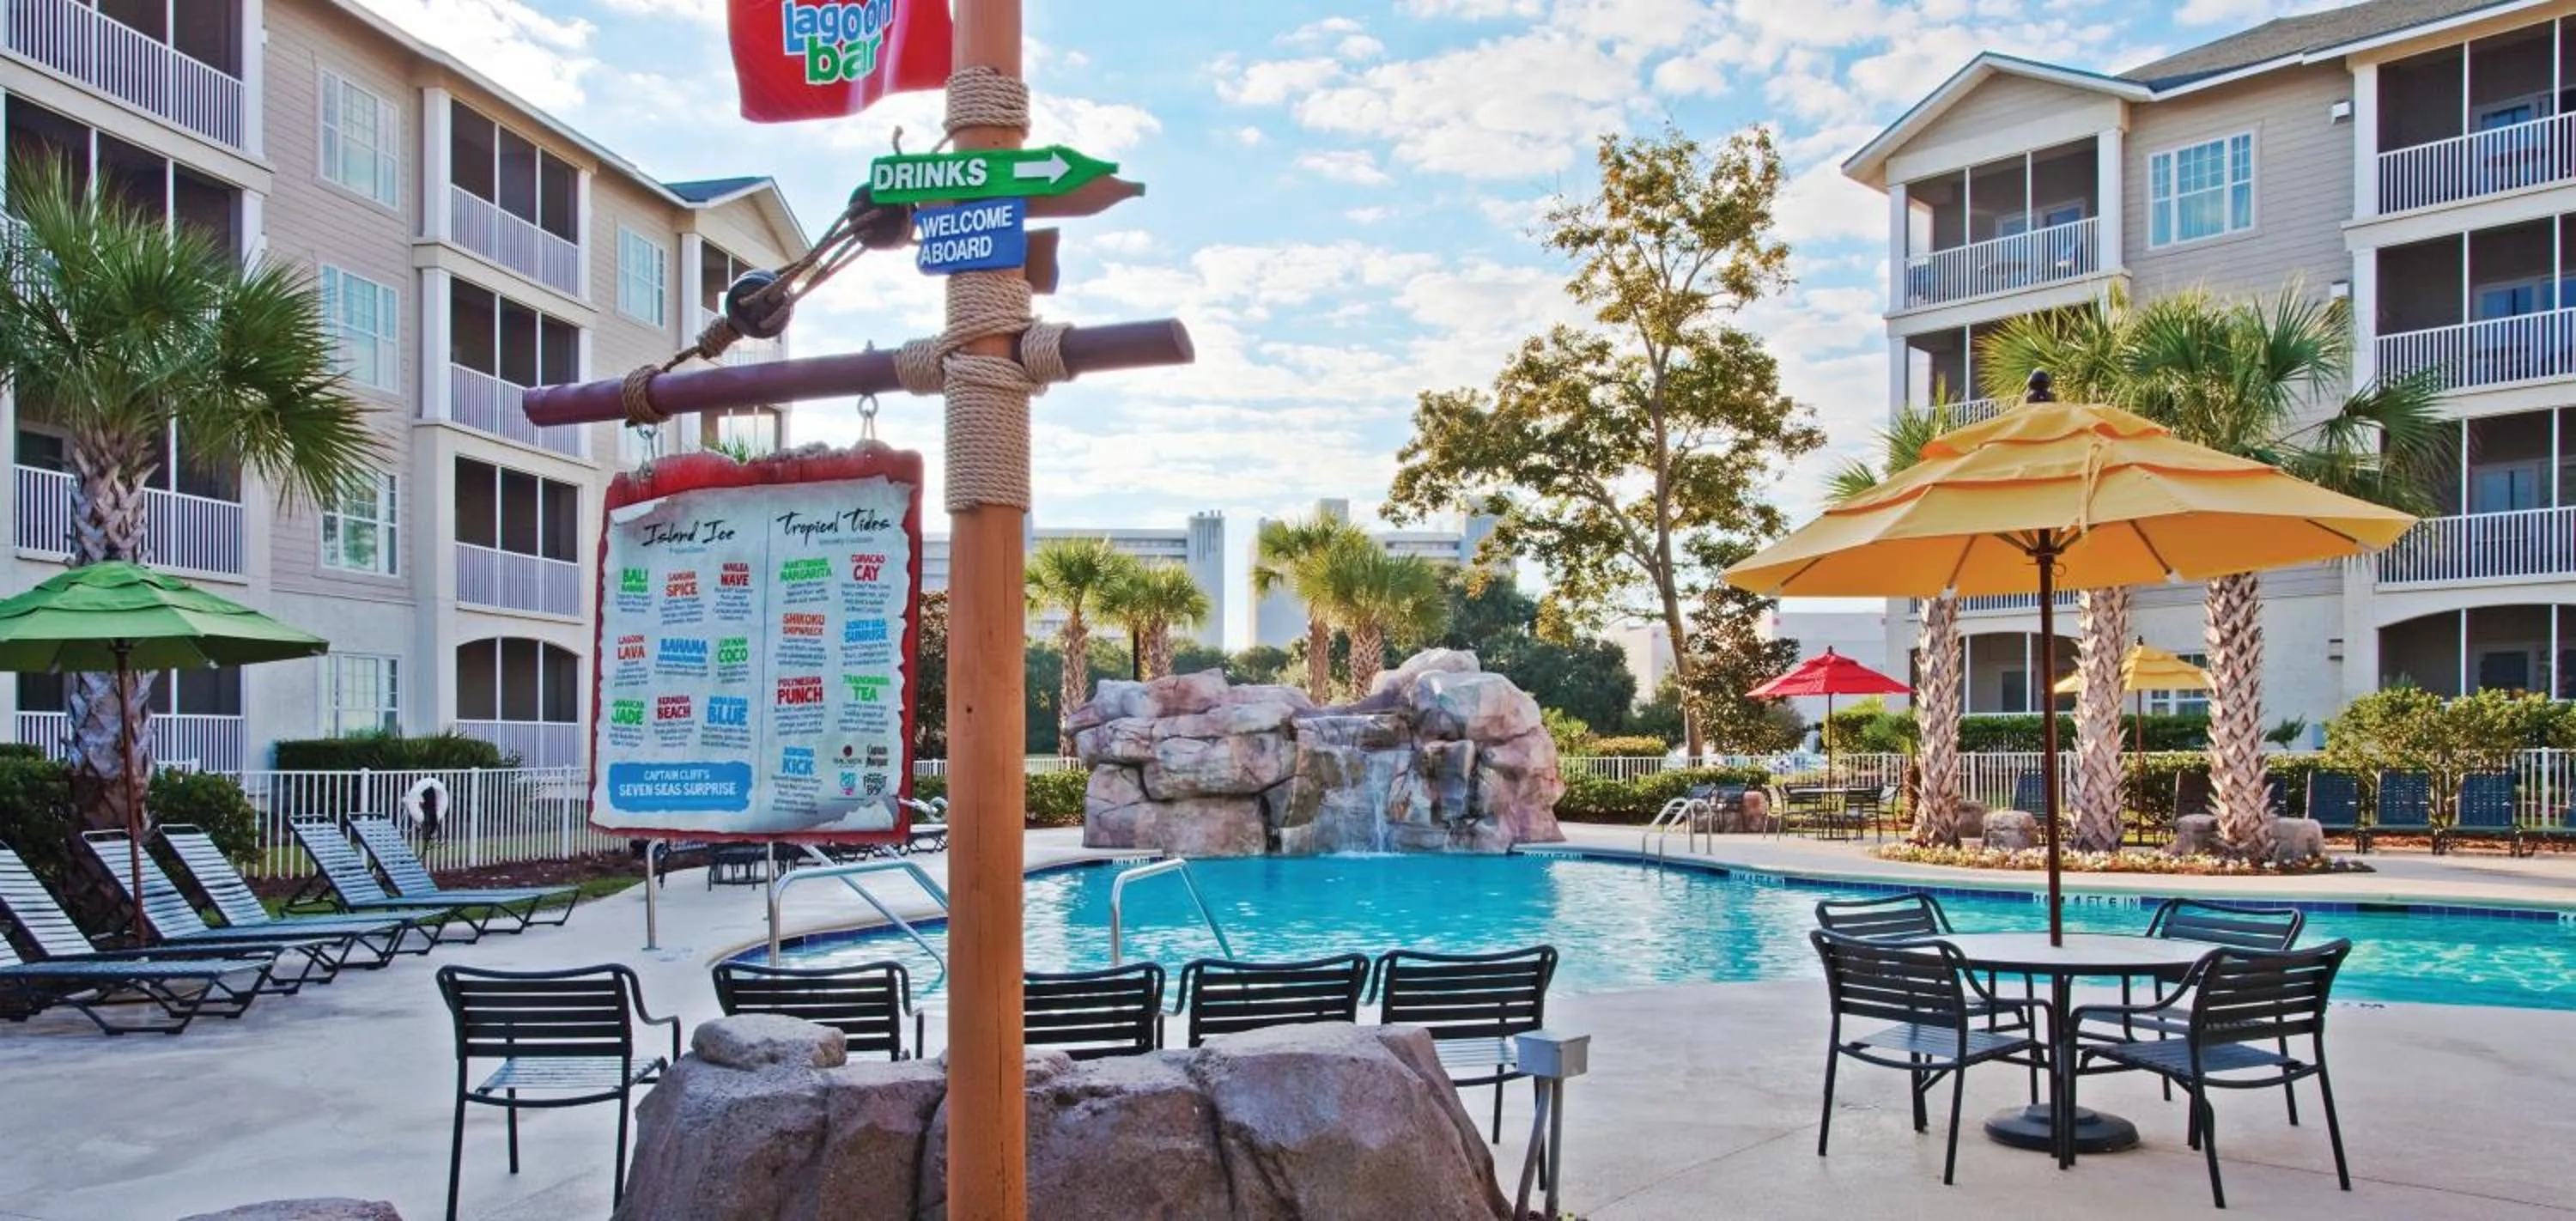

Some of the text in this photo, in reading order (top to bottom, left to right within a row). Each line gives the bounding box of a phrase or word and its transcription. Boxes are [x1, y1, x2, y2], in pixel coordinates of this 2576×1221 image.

[806, 28, 882, 84] bar
[873, 158, 987, 191] DRINKS
[922, 205, 1013, 238] WELCOME
[920, 236, 993, 265] ABOARD
[641, 519, 735, 546] Island Ice
[776, 507, 890, 547] Tropical Tides
[623, 568, 648, 582] BALI
[720, 573, 750, 586] WAVE
[854, 565, 880, 581] CAY
[665, 582, 698, 597] SPICE
[783, 612, 825, 625] SHIKOKU
[617, 646, 647, 660] LAVA
[659, 638, 708, 653] BAHAMA
[718, 647, 748, 663] COCO
[778, 687, 823, 704] PUNCH
[853, 687, 878, 702] TEA
[611, 708, 644, 726] JADE
[657, 706, 691, 720] BEACH
[707, 706, 748, 725] BLUE
[782, 757, 814, 774] KICK
[644, 768, 710, 781] CAPTAIN CLIFF'S
[618, 781, 736, 797] SEVEN SEAS SURPRISE
[2087, 896, 2103, 907] FT
